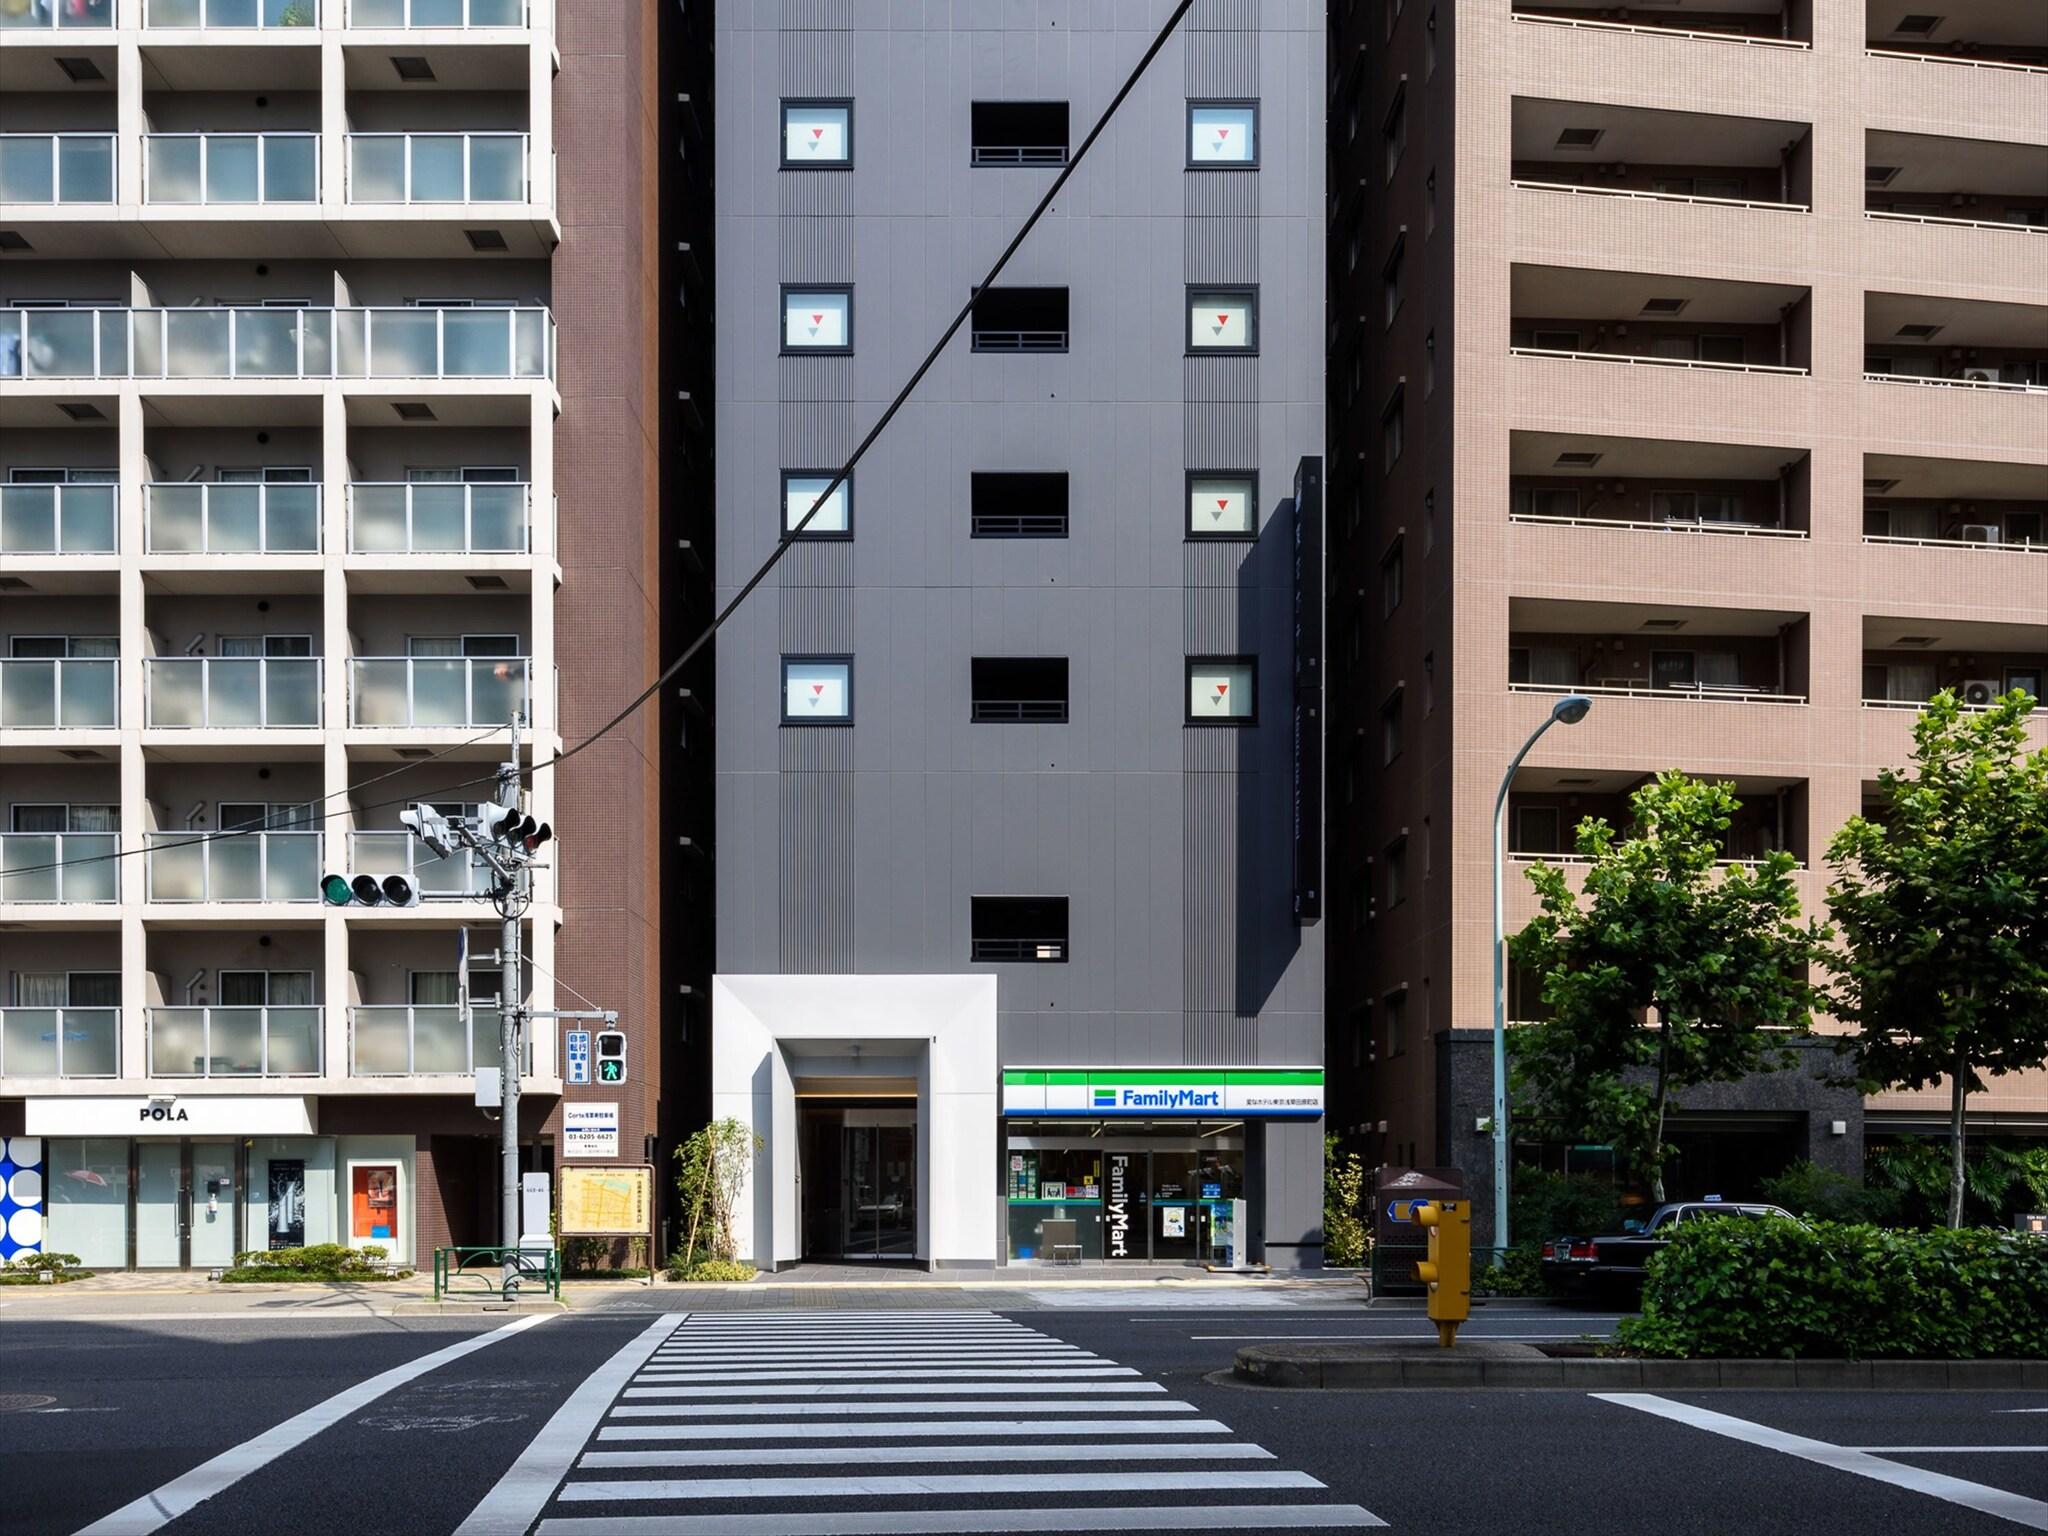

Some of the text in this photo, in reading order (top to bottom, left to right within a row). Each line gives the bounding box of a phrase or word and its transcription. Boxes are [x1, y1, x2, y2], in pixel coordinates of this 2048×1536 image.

[570, 1034, 578, 1061] 自転車
[579, 1034, 587, 1061] 歩行者
[574, 1062, 583, 1081] 専用
[1123, 1089, 1219, 1108] FamilyMart
[140, 1108, 189, 1121] POLA
[1108, 1156, 1128, 1256] FamilyMart
